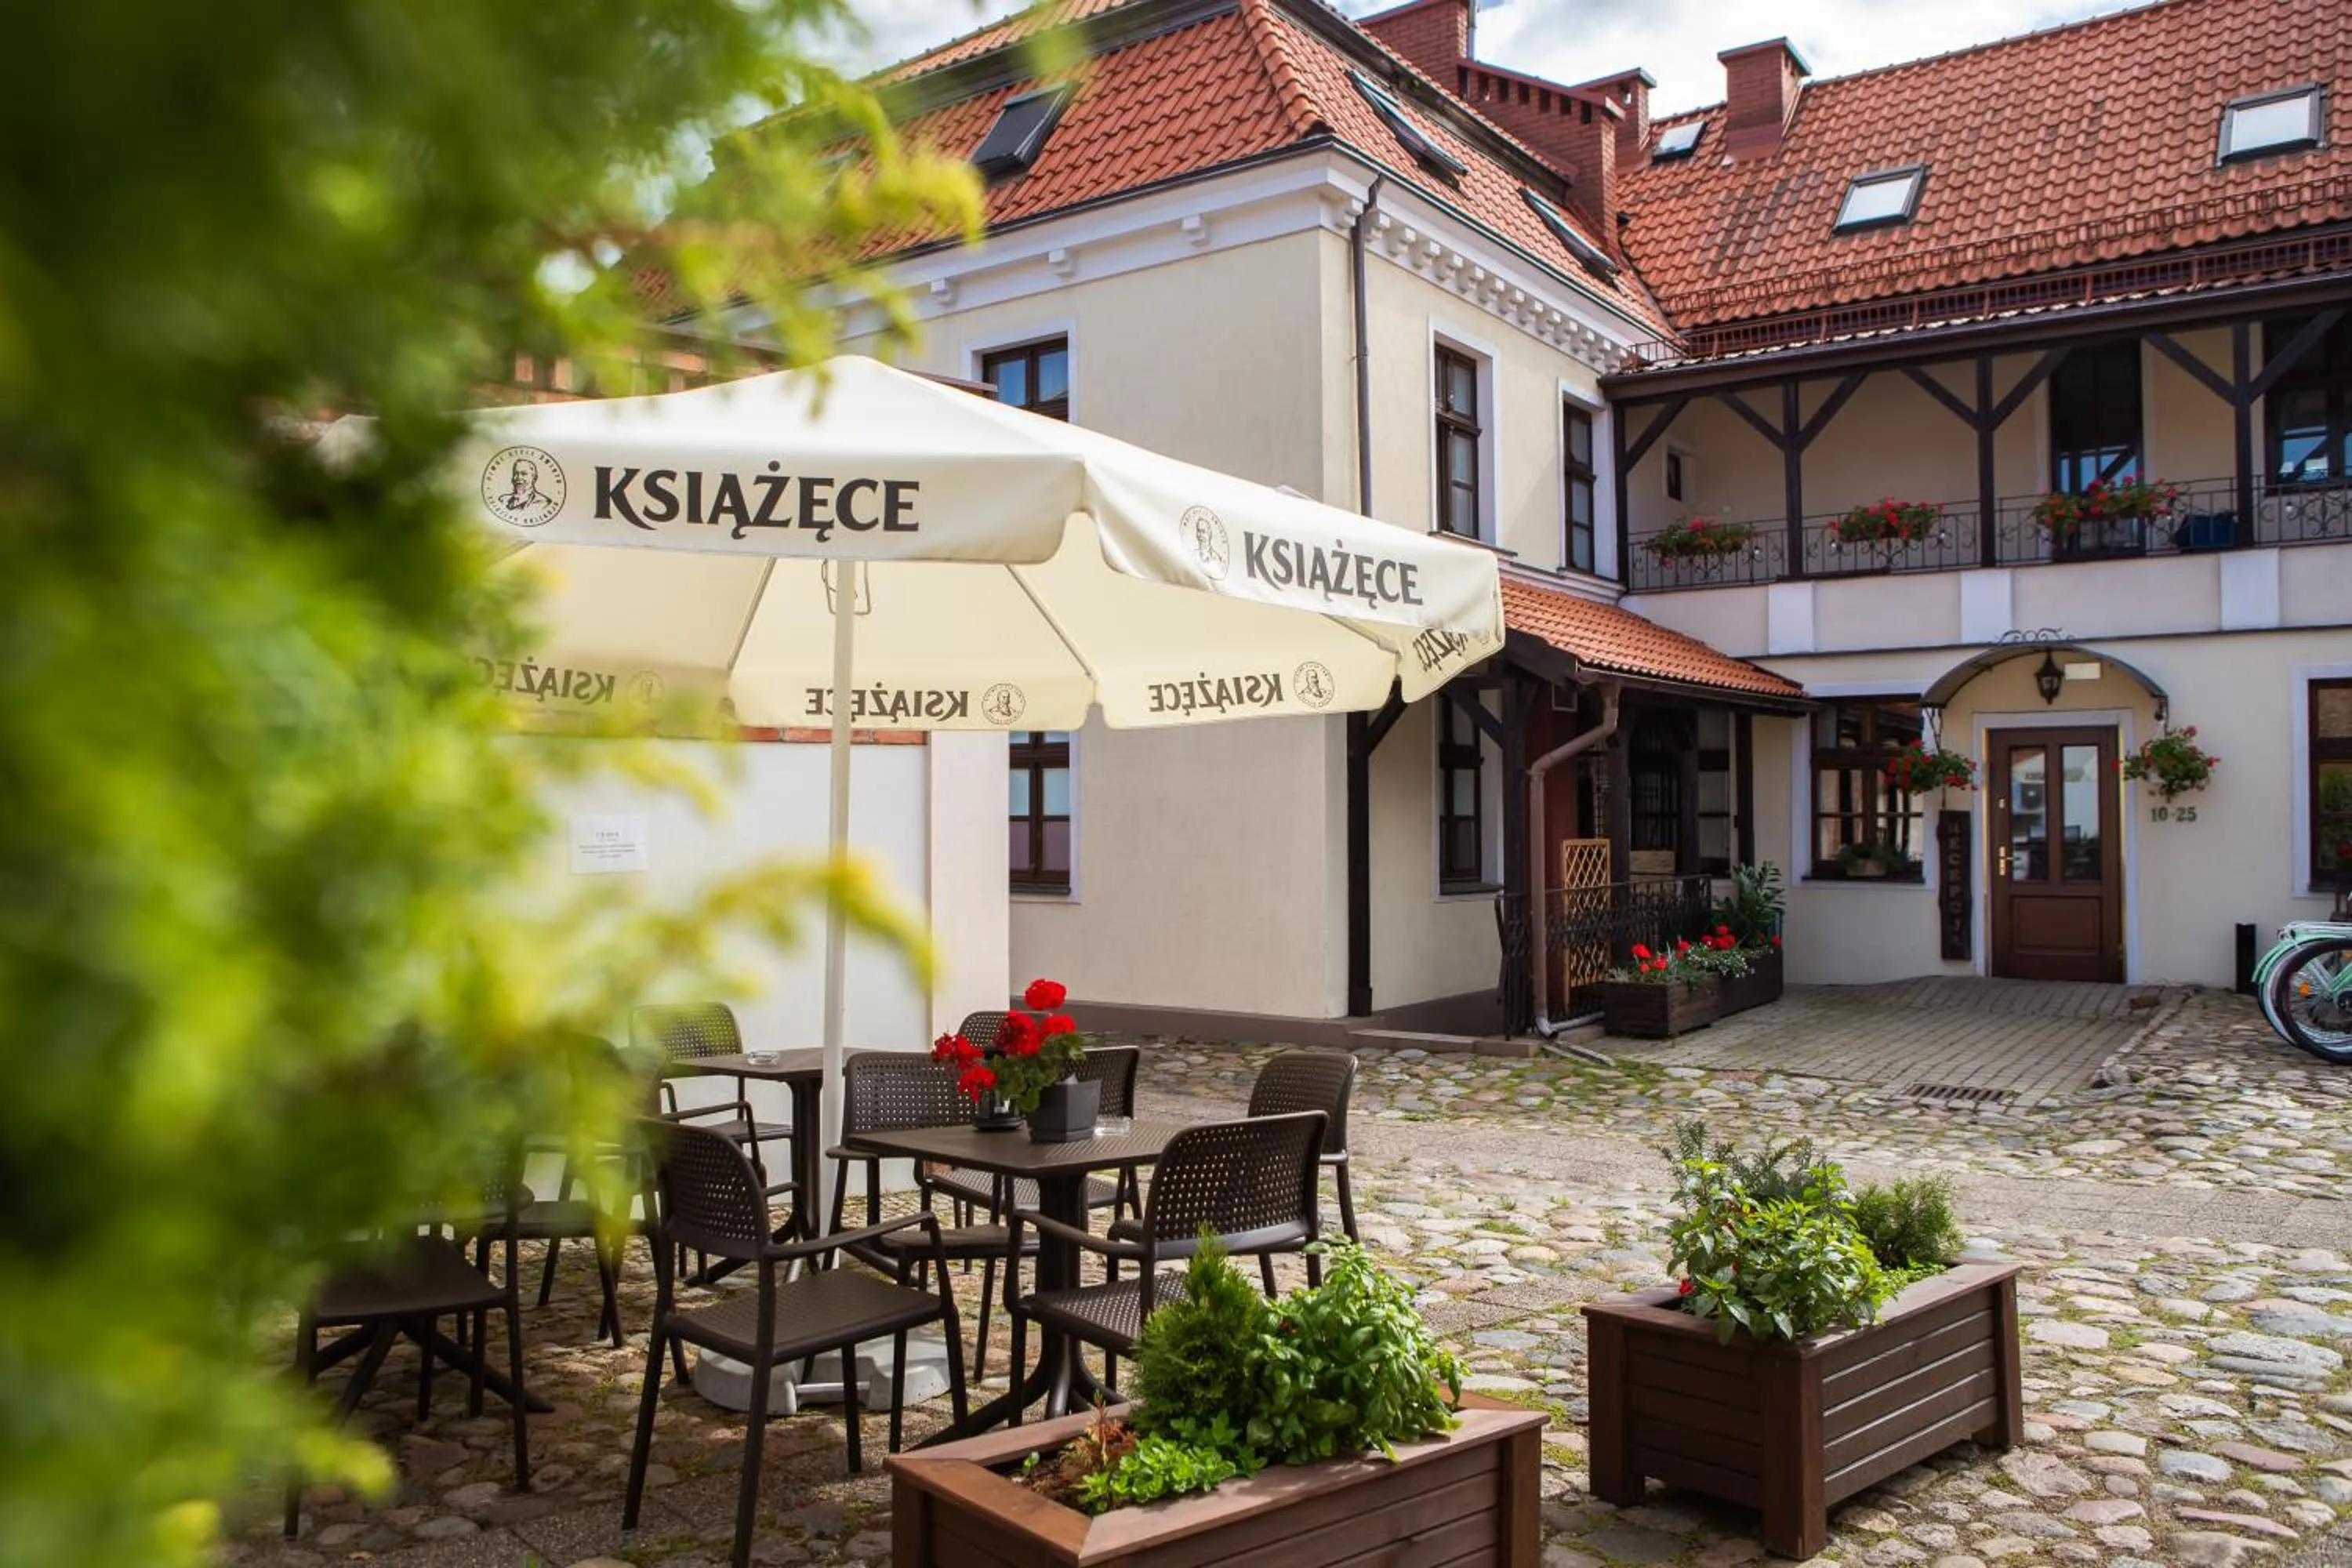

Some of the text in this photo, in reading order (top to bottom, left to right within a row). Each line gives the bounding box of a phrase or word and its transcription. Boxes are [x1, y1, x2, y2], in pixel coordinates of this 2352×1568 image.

[593, 460, 920, 543] KSIĄŻĘCE
[1243, 532, 1423, 609] KSIĄŻĘCE
[2151, 805, 2198, 822] 10-25
